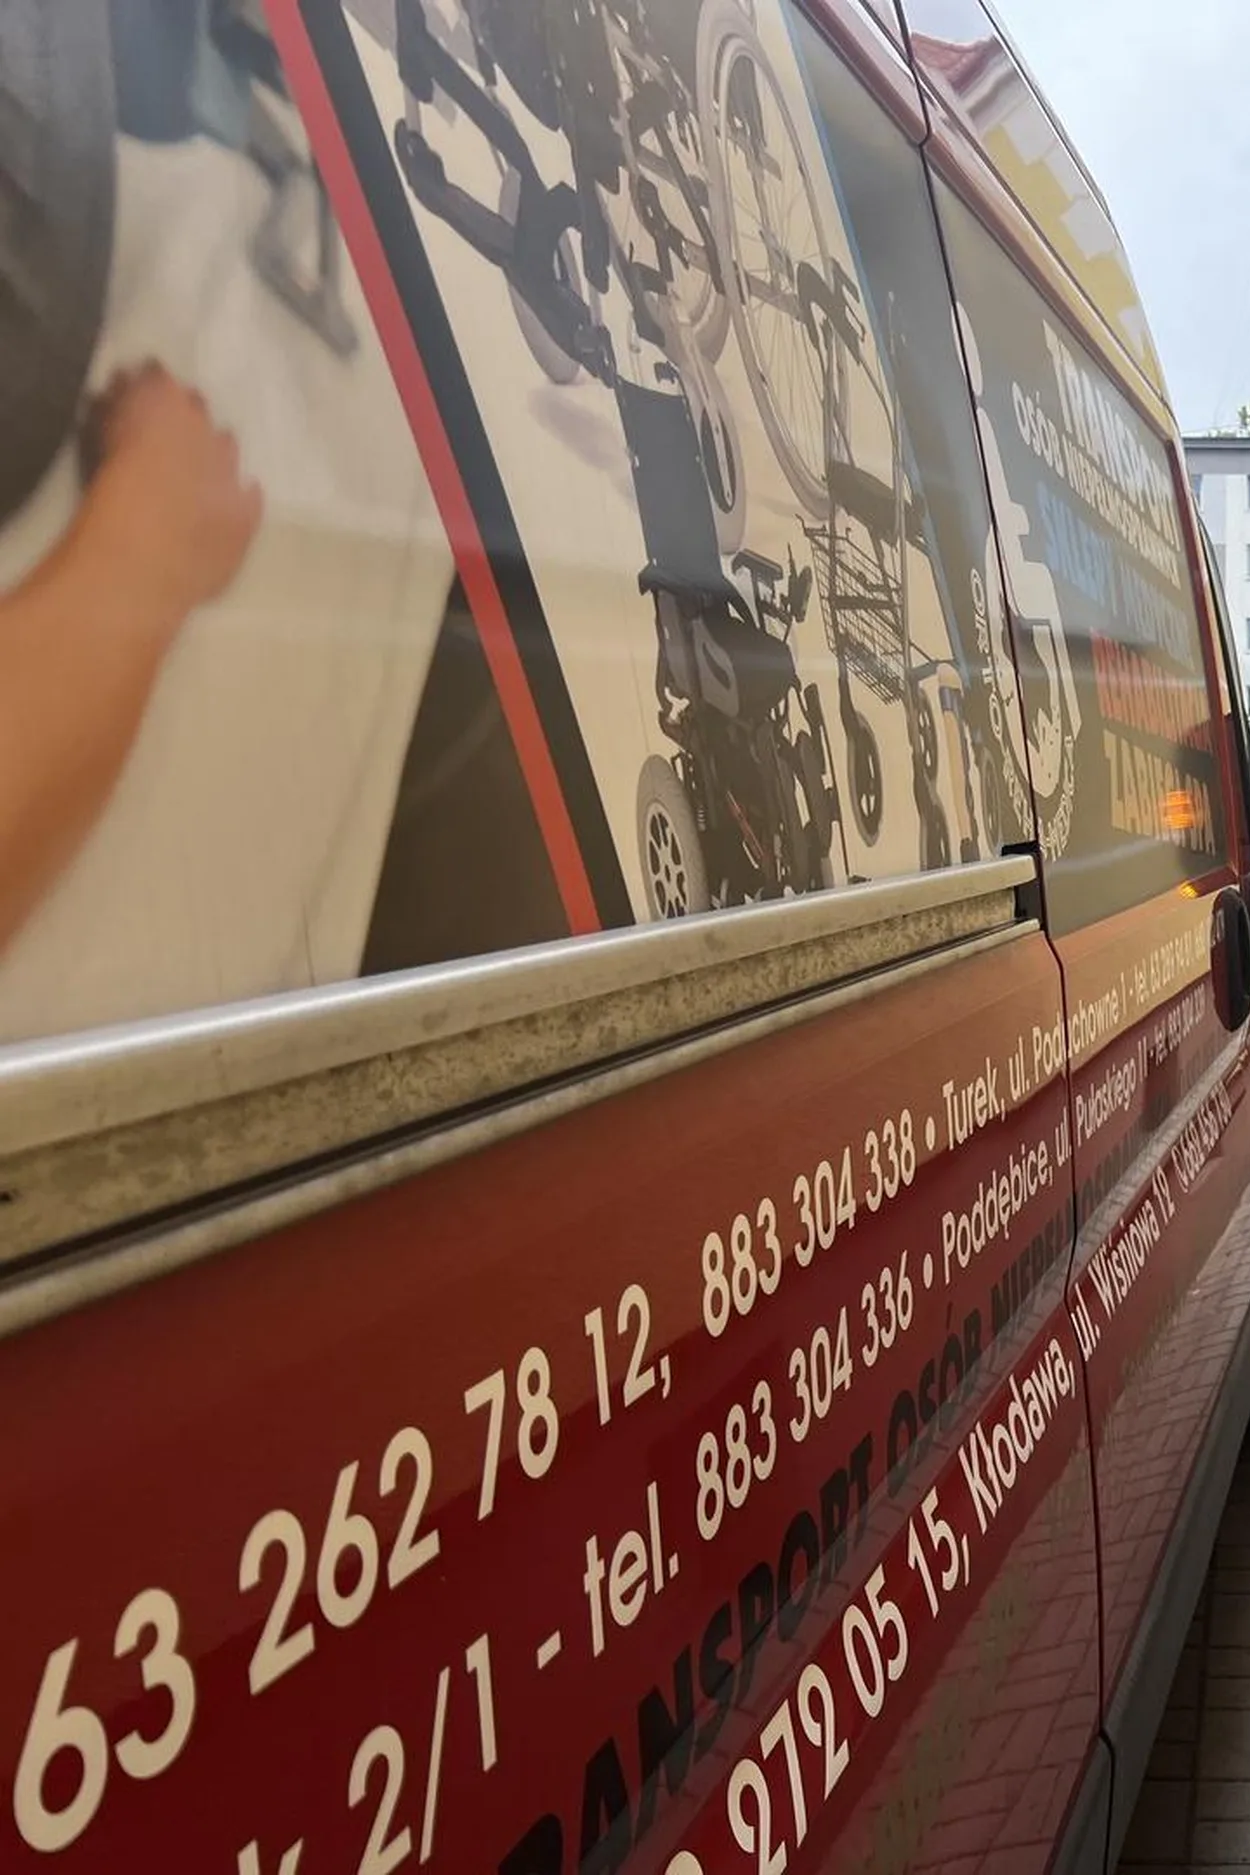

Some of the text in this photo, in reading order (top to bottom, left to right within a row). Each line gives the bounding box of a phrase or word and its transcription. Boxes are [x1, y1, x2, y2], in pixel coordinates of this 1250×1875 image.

[1012, 381, 1064, 479] OSÓB
[1043, 319, 1181, 552] TRANSPORT
[14, 1589, 196, 1853] 63
[239, 1427, 440, 1695] 262
[465, 1347, 559, 1522] 78
[584, 1284, 671, 1426] 12,
[702, 1198, 782, 1338] 883
[793, 1146, 857, 1268] 304
[864, 1109, 916, 1212] 338
[942, 1057, 1006, 1151] Turek,
[1009, 1036, 1031, 1101] ul.
[584, 1481, 680, 1657] tel.
[696, 1380, 777, 1540] 883
[788, 1305, 853, 1442] 304
[861, 1249, 914, 1368] 336
[942, 1139, 1054, 1285] Poddębice,
[1055, 1106, 1073, 1167] ul.
[727, 1663, 850, 1875] 272
[842, 1564, 908, 1718] 05
[907, 1486, 970, 1618] 15,
[958, 1338, 1075, 1535] Kłodawa,
[1071, 1283, 1101, 1361] ul.
[1088, 1198, 1161, 1320] Wiśniowa
[1152, 1166, 1176, 1226] 12
